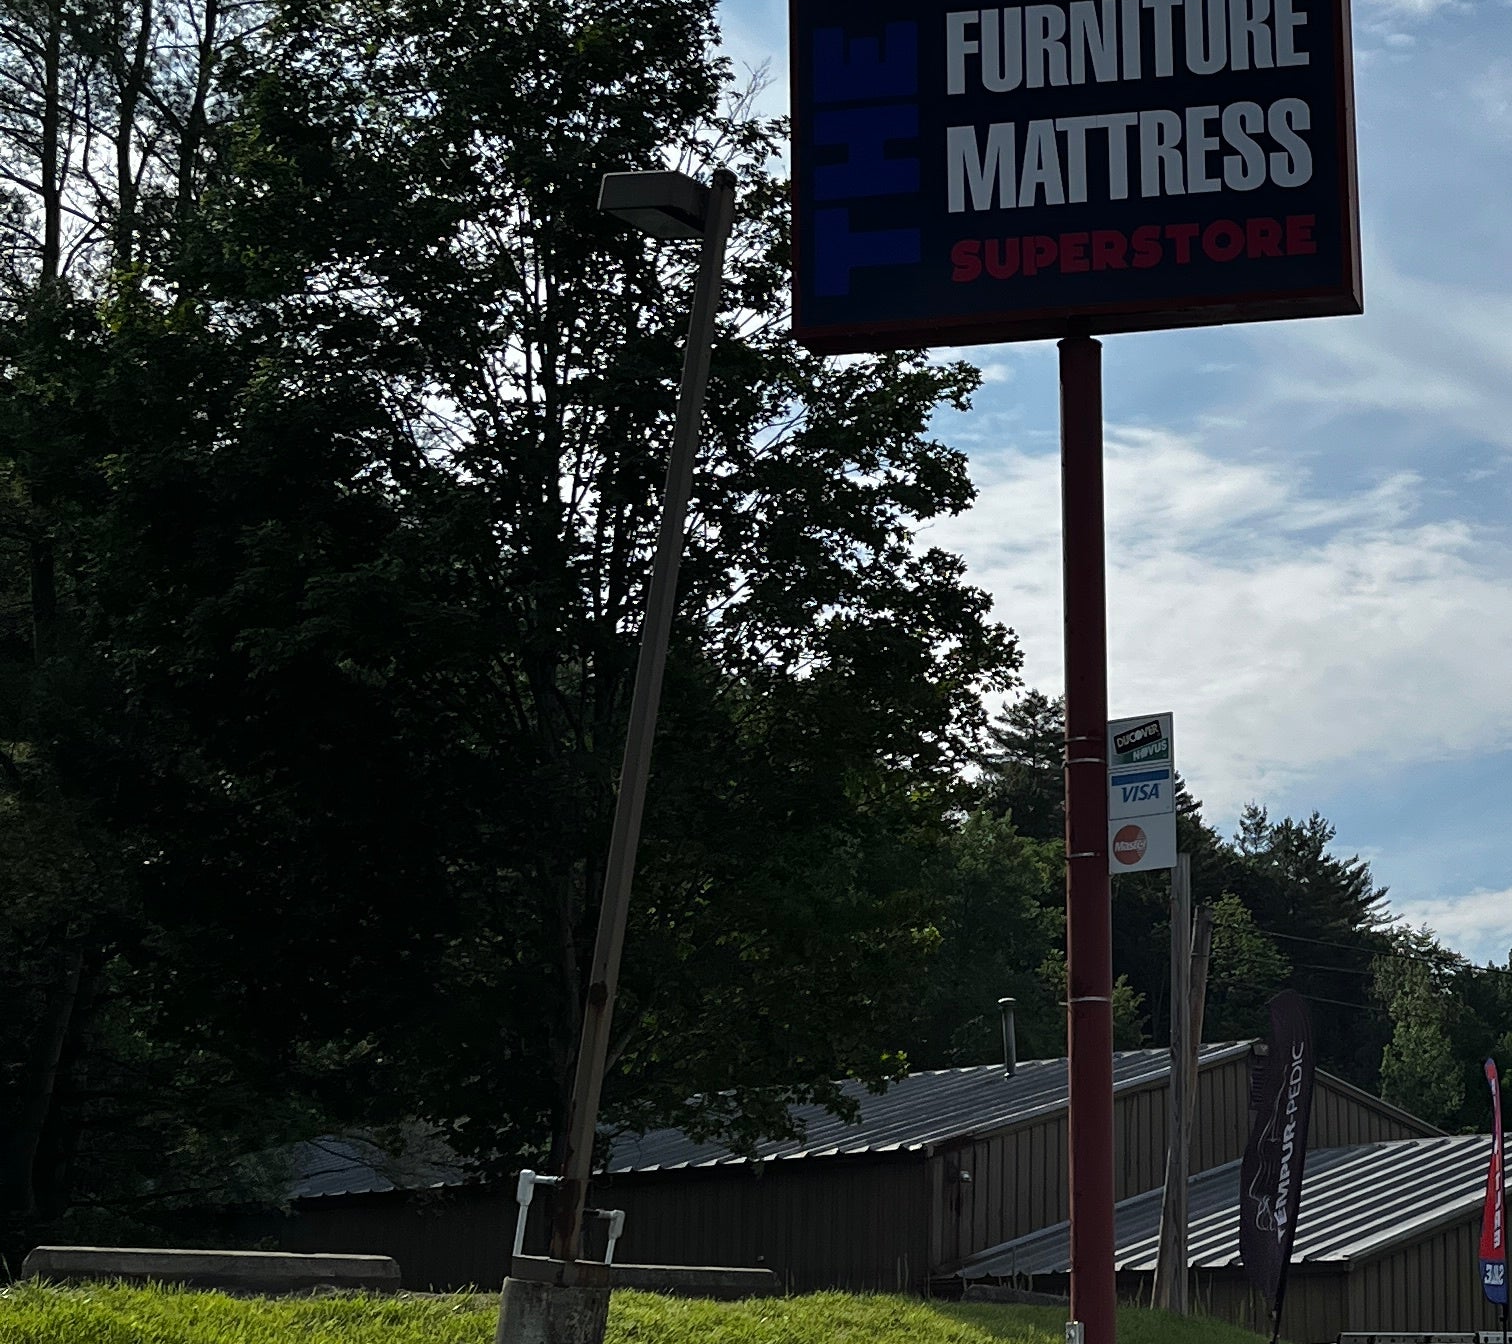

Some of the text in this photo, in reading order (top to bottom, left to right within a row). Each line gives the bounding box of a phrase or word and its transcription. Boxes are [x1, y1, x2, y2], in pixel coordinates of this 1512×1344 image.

[812, 20, 921, 296] THE
[946, 97, 1312, 213] MATTRESS
[950, 214, 1317, 283] SUPERSTORE
[1121, 783, 1160, 803] VISA
[1132, 739, 1168, 762] NOVUS
[1273, 1040, 1306, 1244] TEMPUR-PEDIC
